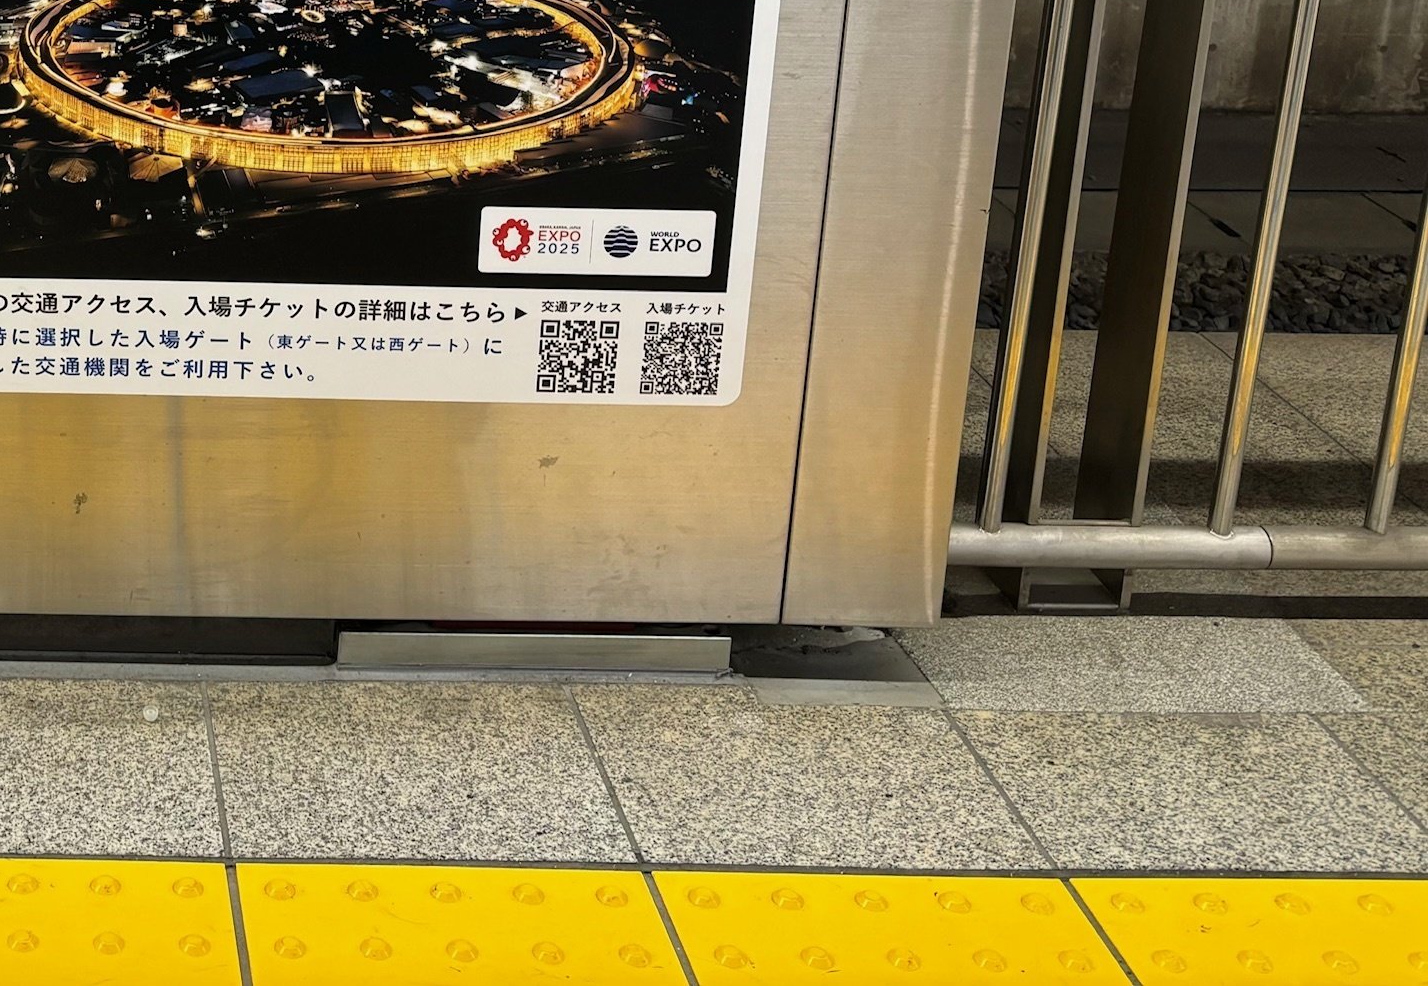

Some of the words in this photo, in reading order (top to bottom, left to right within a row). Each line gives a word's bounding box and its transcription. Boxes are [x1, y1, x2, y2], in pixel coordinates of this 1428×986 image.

[537, 230, 581, 242] EXPO
[537, 243, 580, 254] 2025
[649, 239, 702, 253] EXPO
[541, 300, 622, 314] 交通アクセス
[646, 302, 726, 316] 入場チケット
